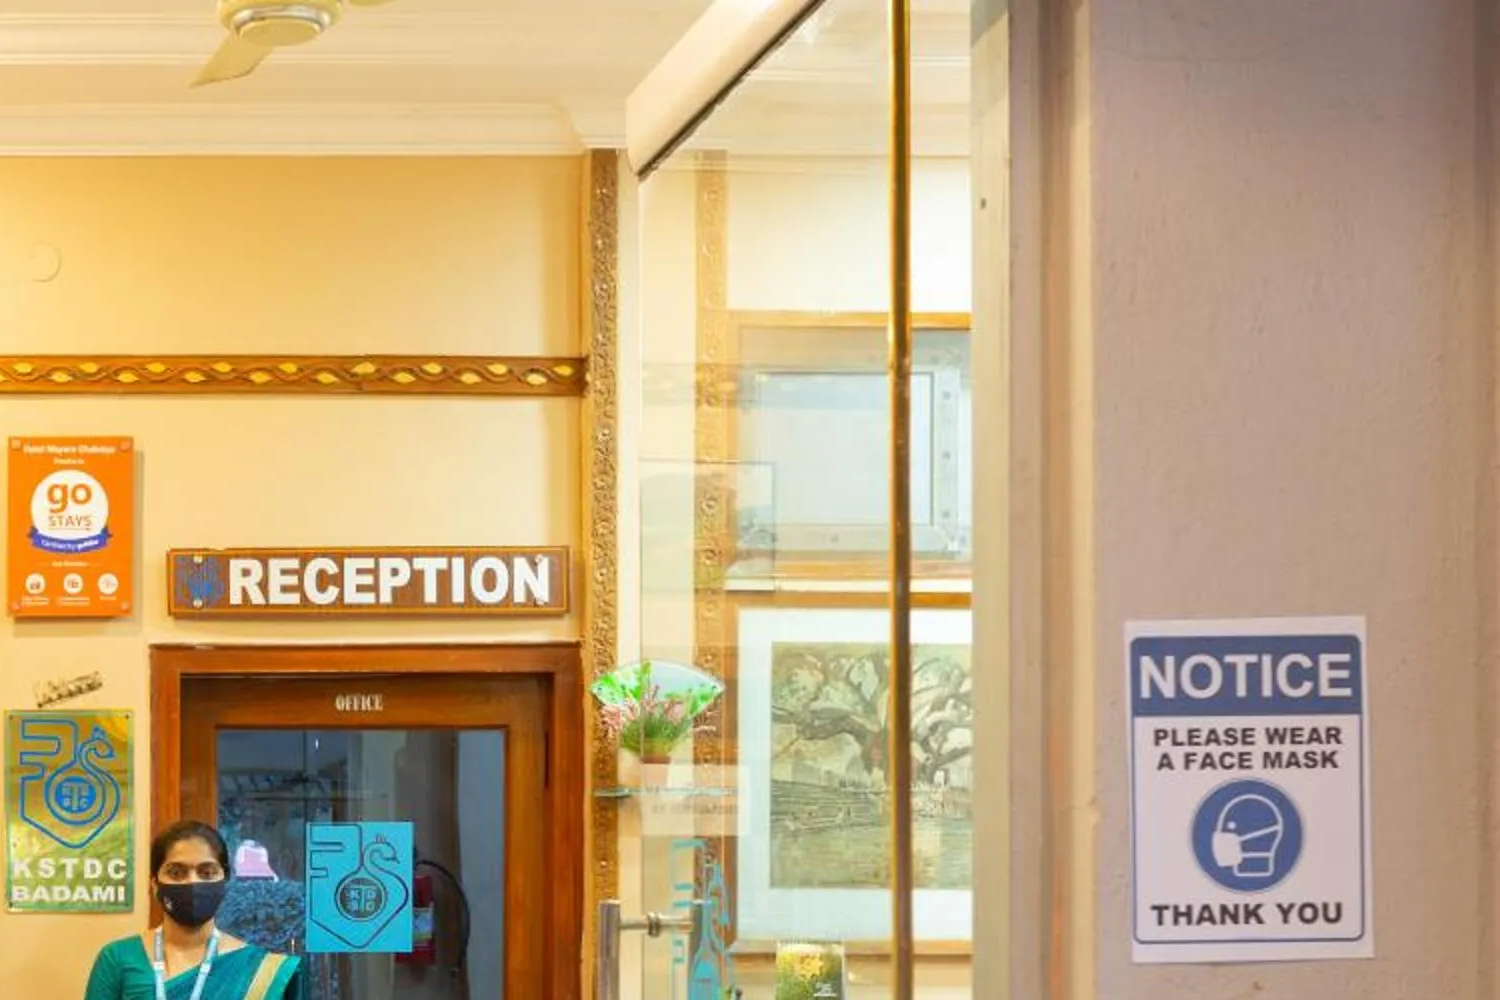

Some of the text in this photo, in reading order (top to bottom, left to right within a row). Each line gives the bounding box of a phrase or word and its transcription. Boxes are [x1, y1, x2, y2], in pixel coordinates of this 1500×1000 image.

[46, 483, 93, 513] go
[48, 515, 93, 527] STAYS
[228, 556, 551, 605] RECEPTION
[1139, 653, 1353, 699] NOTICE
[334, 694, 385, 711] OFFICE
[1153, 727, 1342, 747] PLEASE WEAR
[1157, 751, 1339, 771] A FACE MASK
[12, 857, 127, 879] KSTDC
[11, 885, 126, 903] BADAMI
[1151, 902, 1343, 926] THANK YOU
